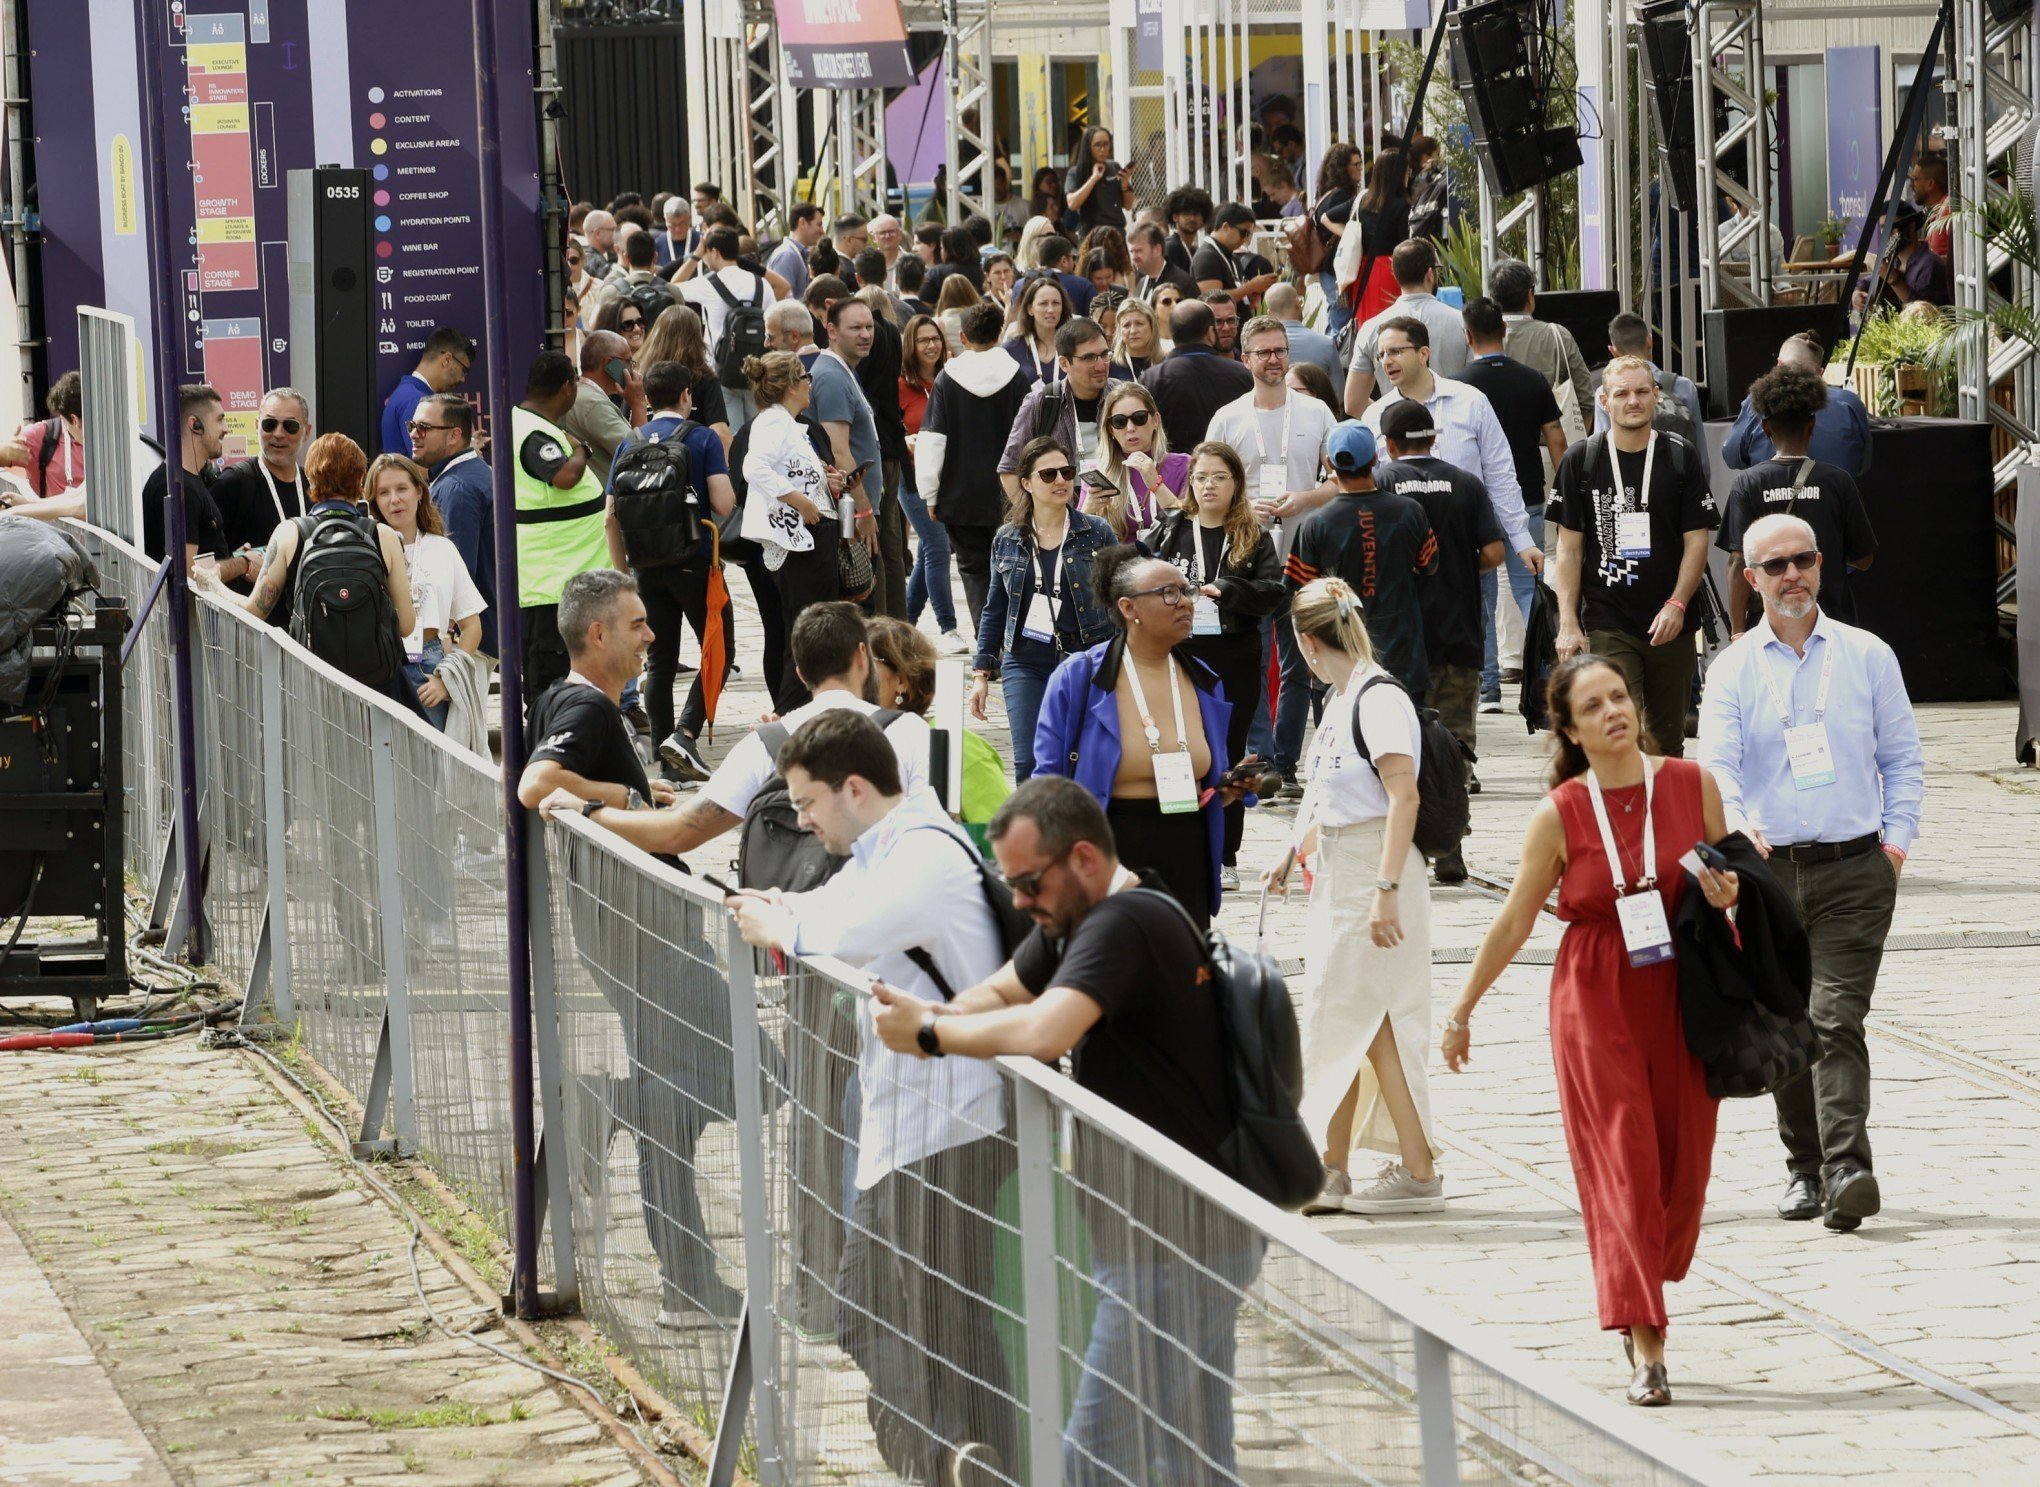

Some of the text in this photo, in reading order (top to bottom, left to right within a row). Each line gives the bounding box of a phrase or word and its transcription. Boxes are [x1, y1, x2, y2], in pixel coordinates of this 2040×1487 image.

[394, 88, 442, 98] ACTIVATIONS
[394, 115, 430, 124] CONTENT
[396, 139, 460, 150] EXCLUSIVE AREAS
[260, 148, 268, 184] LOCKERS
[397, 166, 436, 175] MEETINGS
[326, 186, 359, 198] 0535
[398, 191, 449, 200] COFFEE SHOP
[199, 198, 238, 208] GROWTH
[200, 207, 227, 216] STAGE
[400, 216, 470, 226] HYDRATION POINTS
[402, 244, 422, 252] WINE
[204, 270, 240, 279] CORNER
[403, 266, 479, 277] REGISTRATION POINT
[205, 279, 232, 288] STAGE
[404, 295, 425, 303] FOOD
[406, 320, 435, 328] TOILETS
[406, 342, 426, 350] MEDI
[230, 391, 256, 399] DEMO
[230, 399, 258, 408] STAGE
[1763, 486, 1820, 502] CARREDOR
[1358, 510, 1376, 598] JUVENTUS
